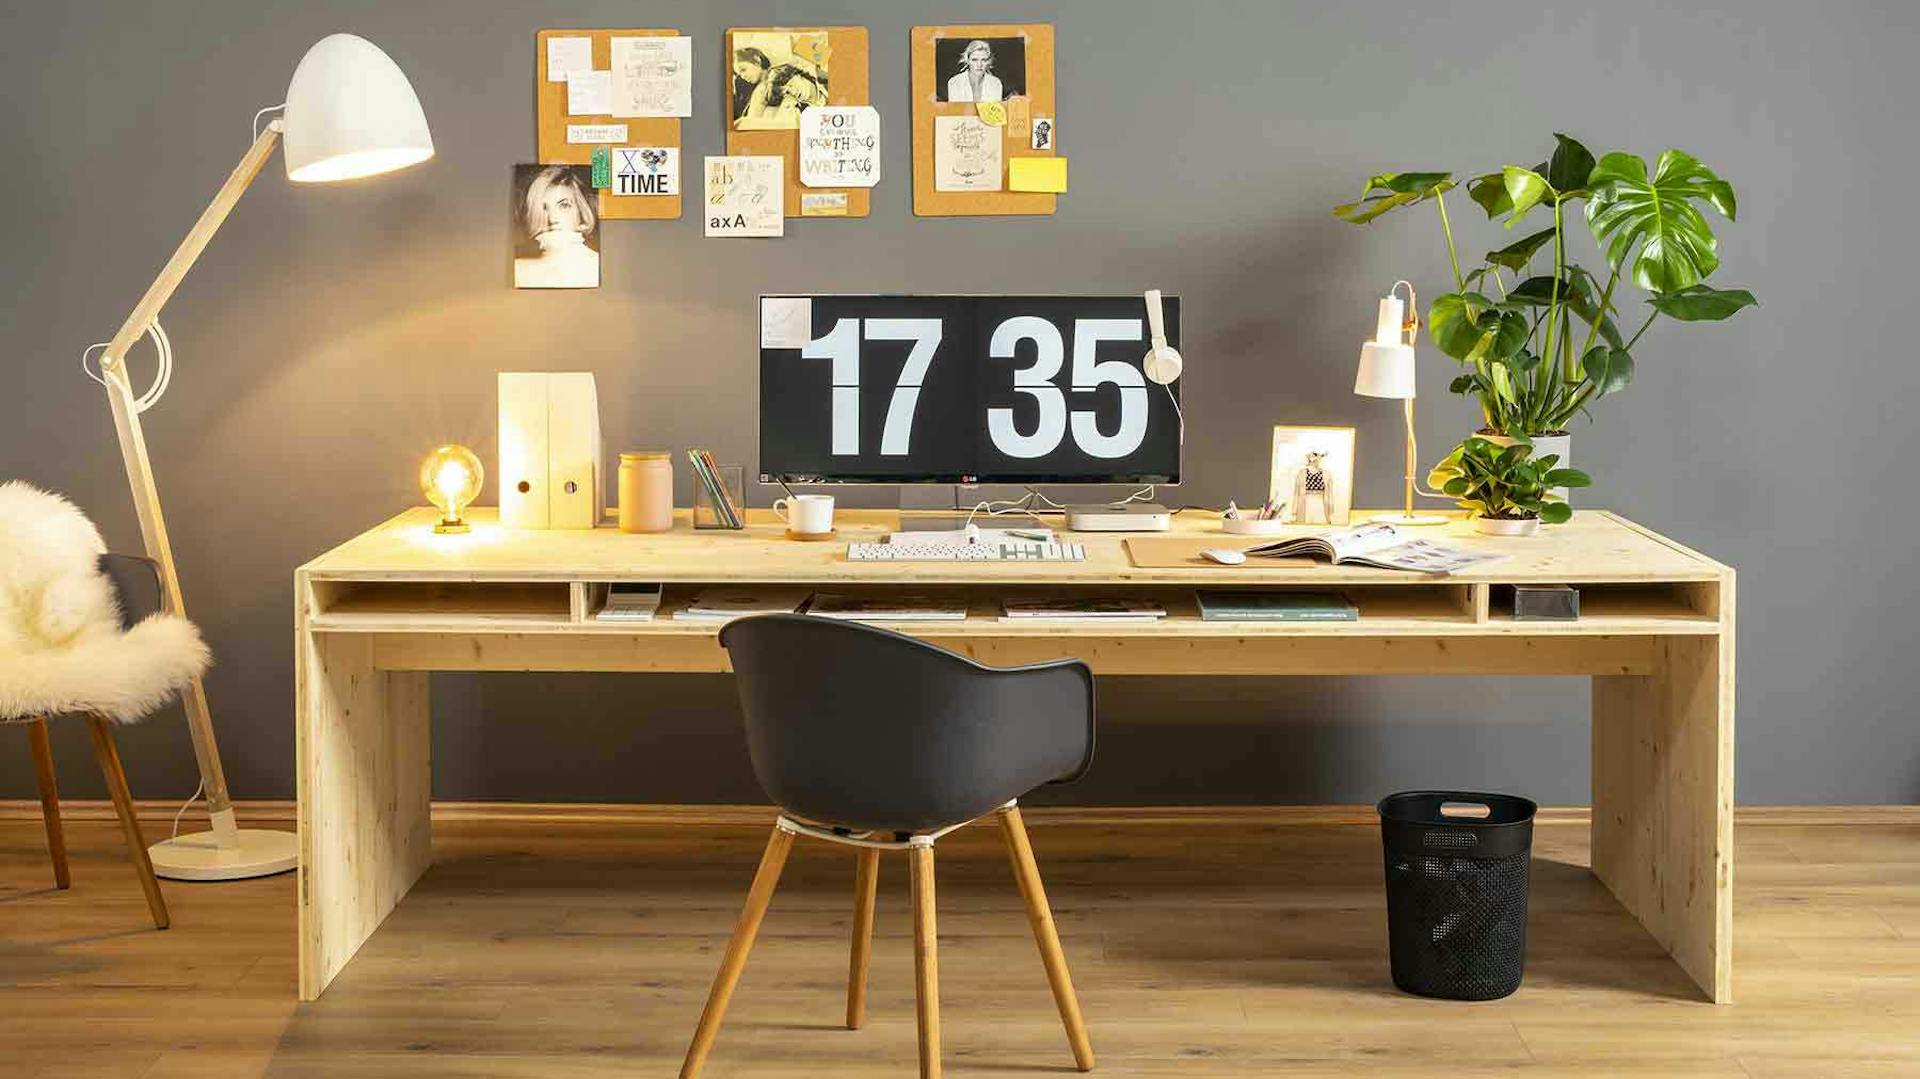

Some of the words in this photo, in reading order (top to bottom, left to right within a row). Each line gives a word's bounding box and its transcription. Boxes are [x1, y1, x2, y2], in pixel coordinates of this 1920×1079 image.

[820, 114, 856, 129] YOU
[617, 149, 641, 174] X
[617, 174, 668, 194] TIME
[802, 318, 942, 455] 17
[987, 315, 1149, 458] 35
